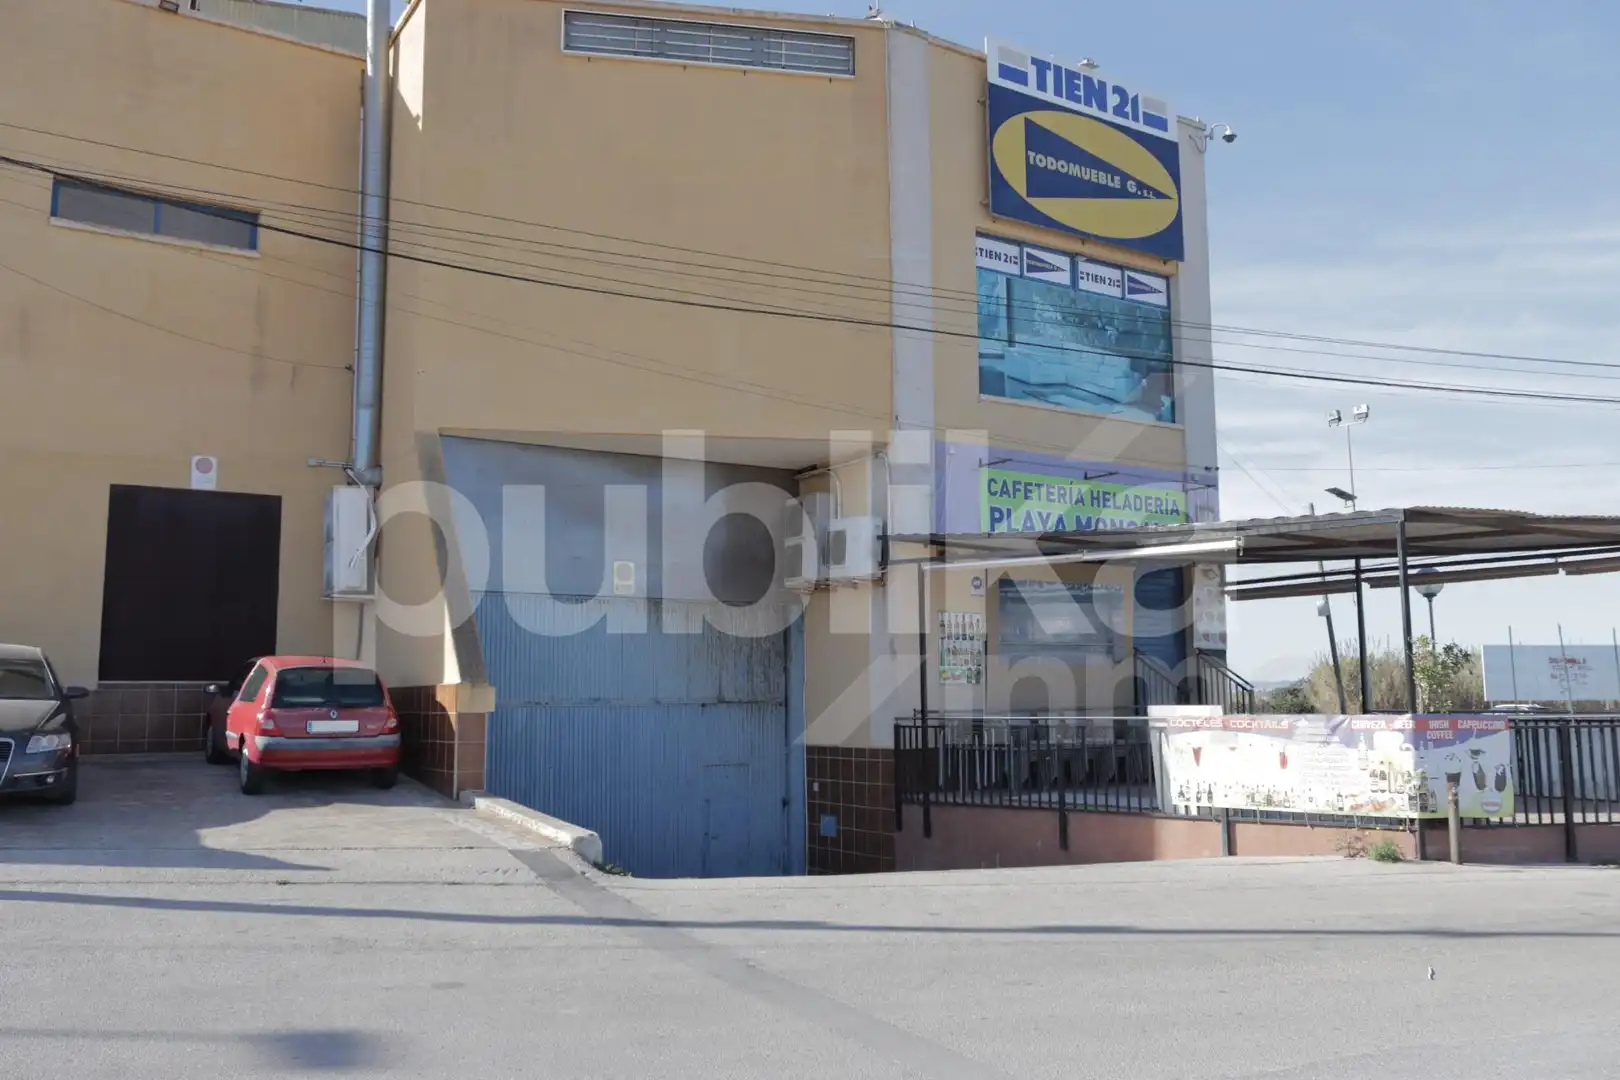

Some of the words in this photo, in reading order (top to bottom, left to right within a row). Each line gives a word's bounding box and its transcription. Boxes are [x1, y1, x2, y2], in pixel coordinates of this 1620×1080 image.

[1031, 56, 1108, 113] TIEN
[1112, 85, 1140, 123] 21
[1028, 150, 1121, 189] TODOMUEBLE
[978, 247, 1001, 262] TIEN
[1085, 272, 1106, 284] TIEN
[987, 478, 1086, 507] CAFETERÍA
[1090, 489, 1181, 517] HELADERÍA
[989, 506, 1067, 533] PLAYA
[1229, 719, 1290, 730] COCKTAILS
[1351, 719, 1387, 730] CERVEZA
[1428, 719, 1450, 730] IRISH
[1426, 730, 1455, 740] COFFEE
